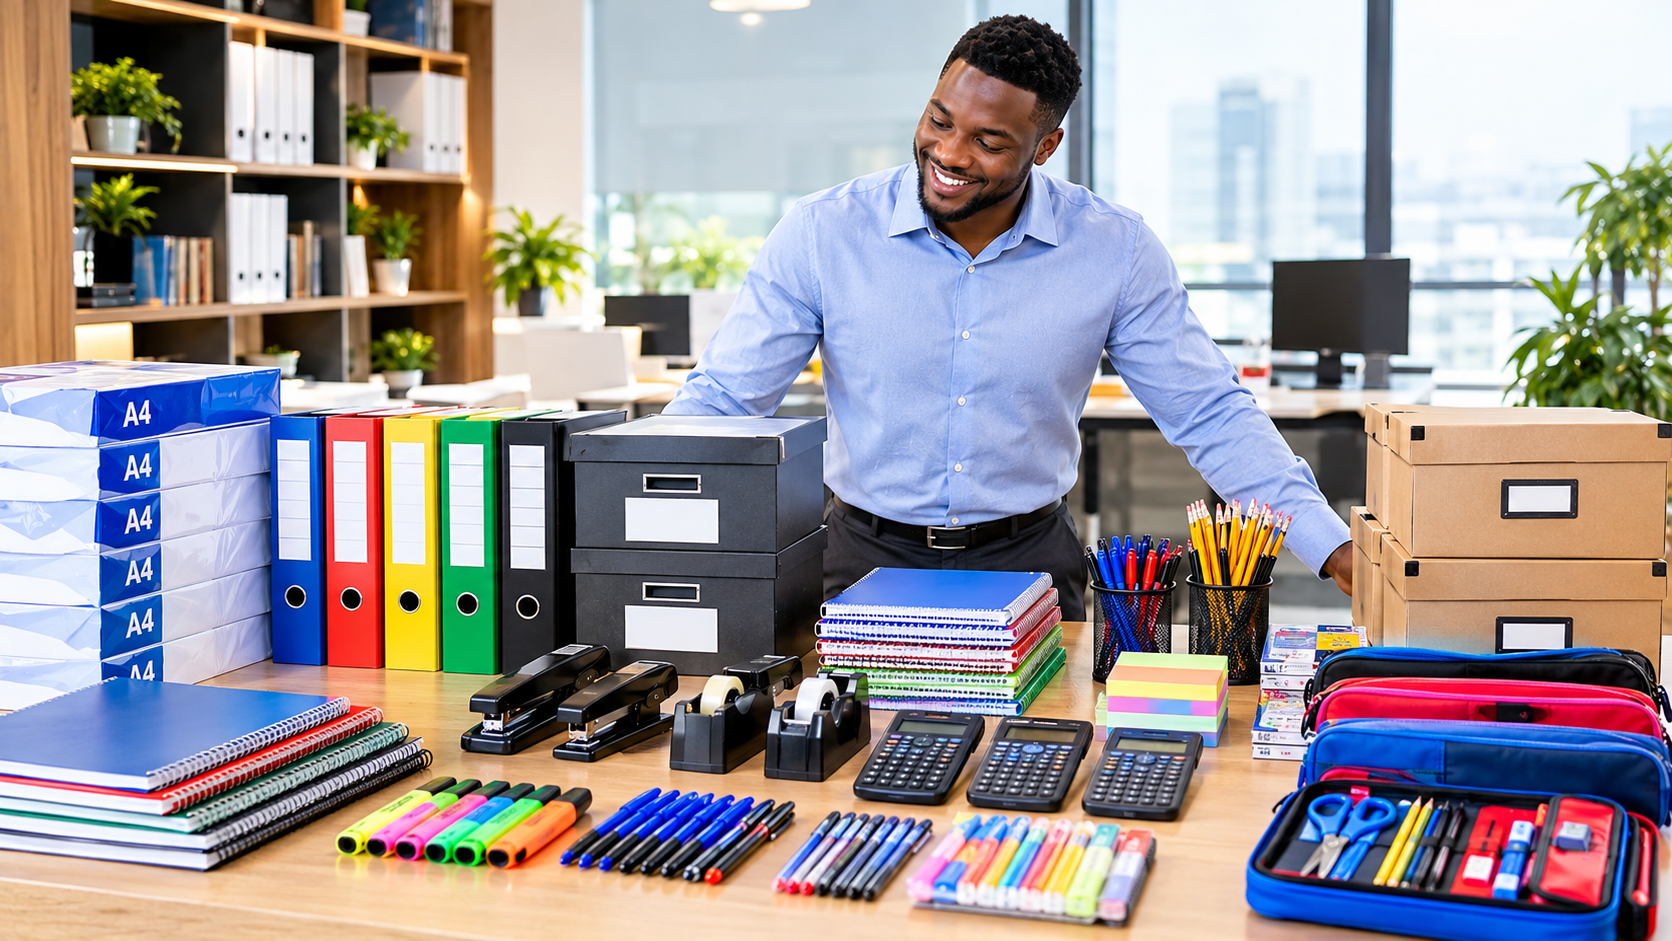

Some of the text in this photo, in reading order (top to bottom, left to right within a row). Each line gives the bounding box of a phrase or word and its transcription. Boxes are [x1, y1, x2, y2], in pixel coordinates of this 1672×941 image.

[123, 400, 152, 428] A4
[123, 453, 152, 482] A4
[124, 505, 153, 535] A4
[125, 557, 154, 587] A4
[126, 608, 155, 639] A4
